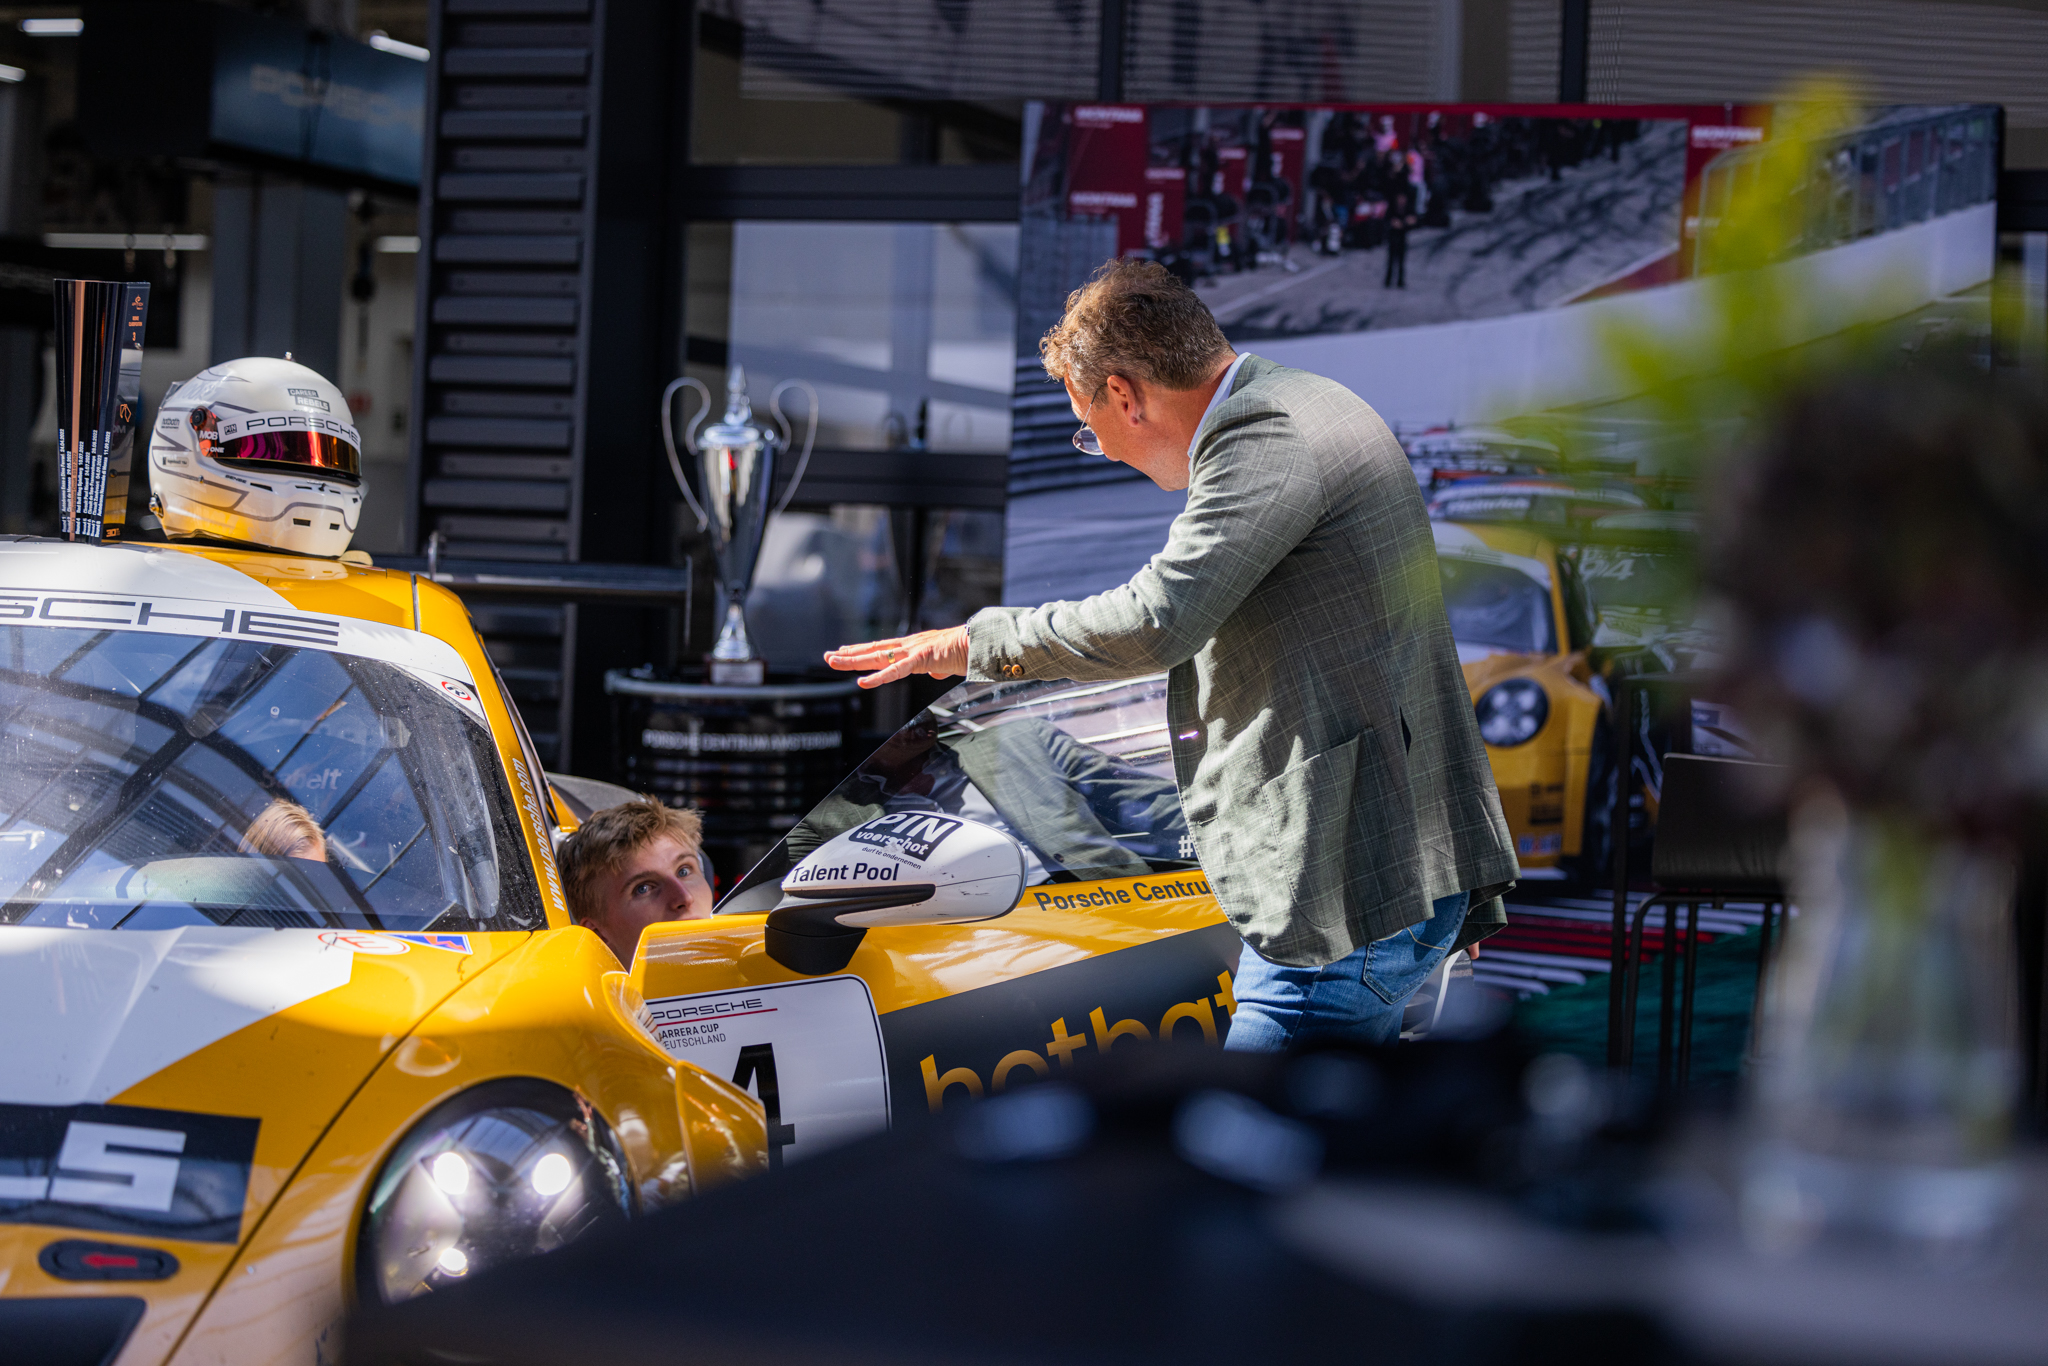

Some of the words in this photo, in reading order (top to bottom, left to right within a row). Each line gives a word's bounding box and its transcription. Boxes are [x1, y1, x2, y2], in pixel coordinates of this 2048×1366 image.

[297, 396, 329, 410] REBELS
[246, 416, 358, 446] PORSCHE
[642, 728, 700, 750] PORSCHE
[512, 758, 566, 912] www.porsche.com
[865, 813, 957, 844] PIN
[856, 830, 929, 856] voorschot
[862, 846, 876, 854] durf
[882, 851, 922, 870] ondernemen
[793, 863, 849, 883] Talent
[853, 862, 900, 881] Pool
[1034, 886, 1132, 912] Porsche
[1132, 879, 1212, 900] Centru
[651, 999, 763, 1020] PORSCHE
[661, 1026, 698, 1040] ARRERA
[700, 1024, 720, 1034] CUP
[664, 1033, 727, 1050] EUTSCHLAND
[919, 969, 1240, 1115] hotbat
[731, 1042, 796, 1170] 4
